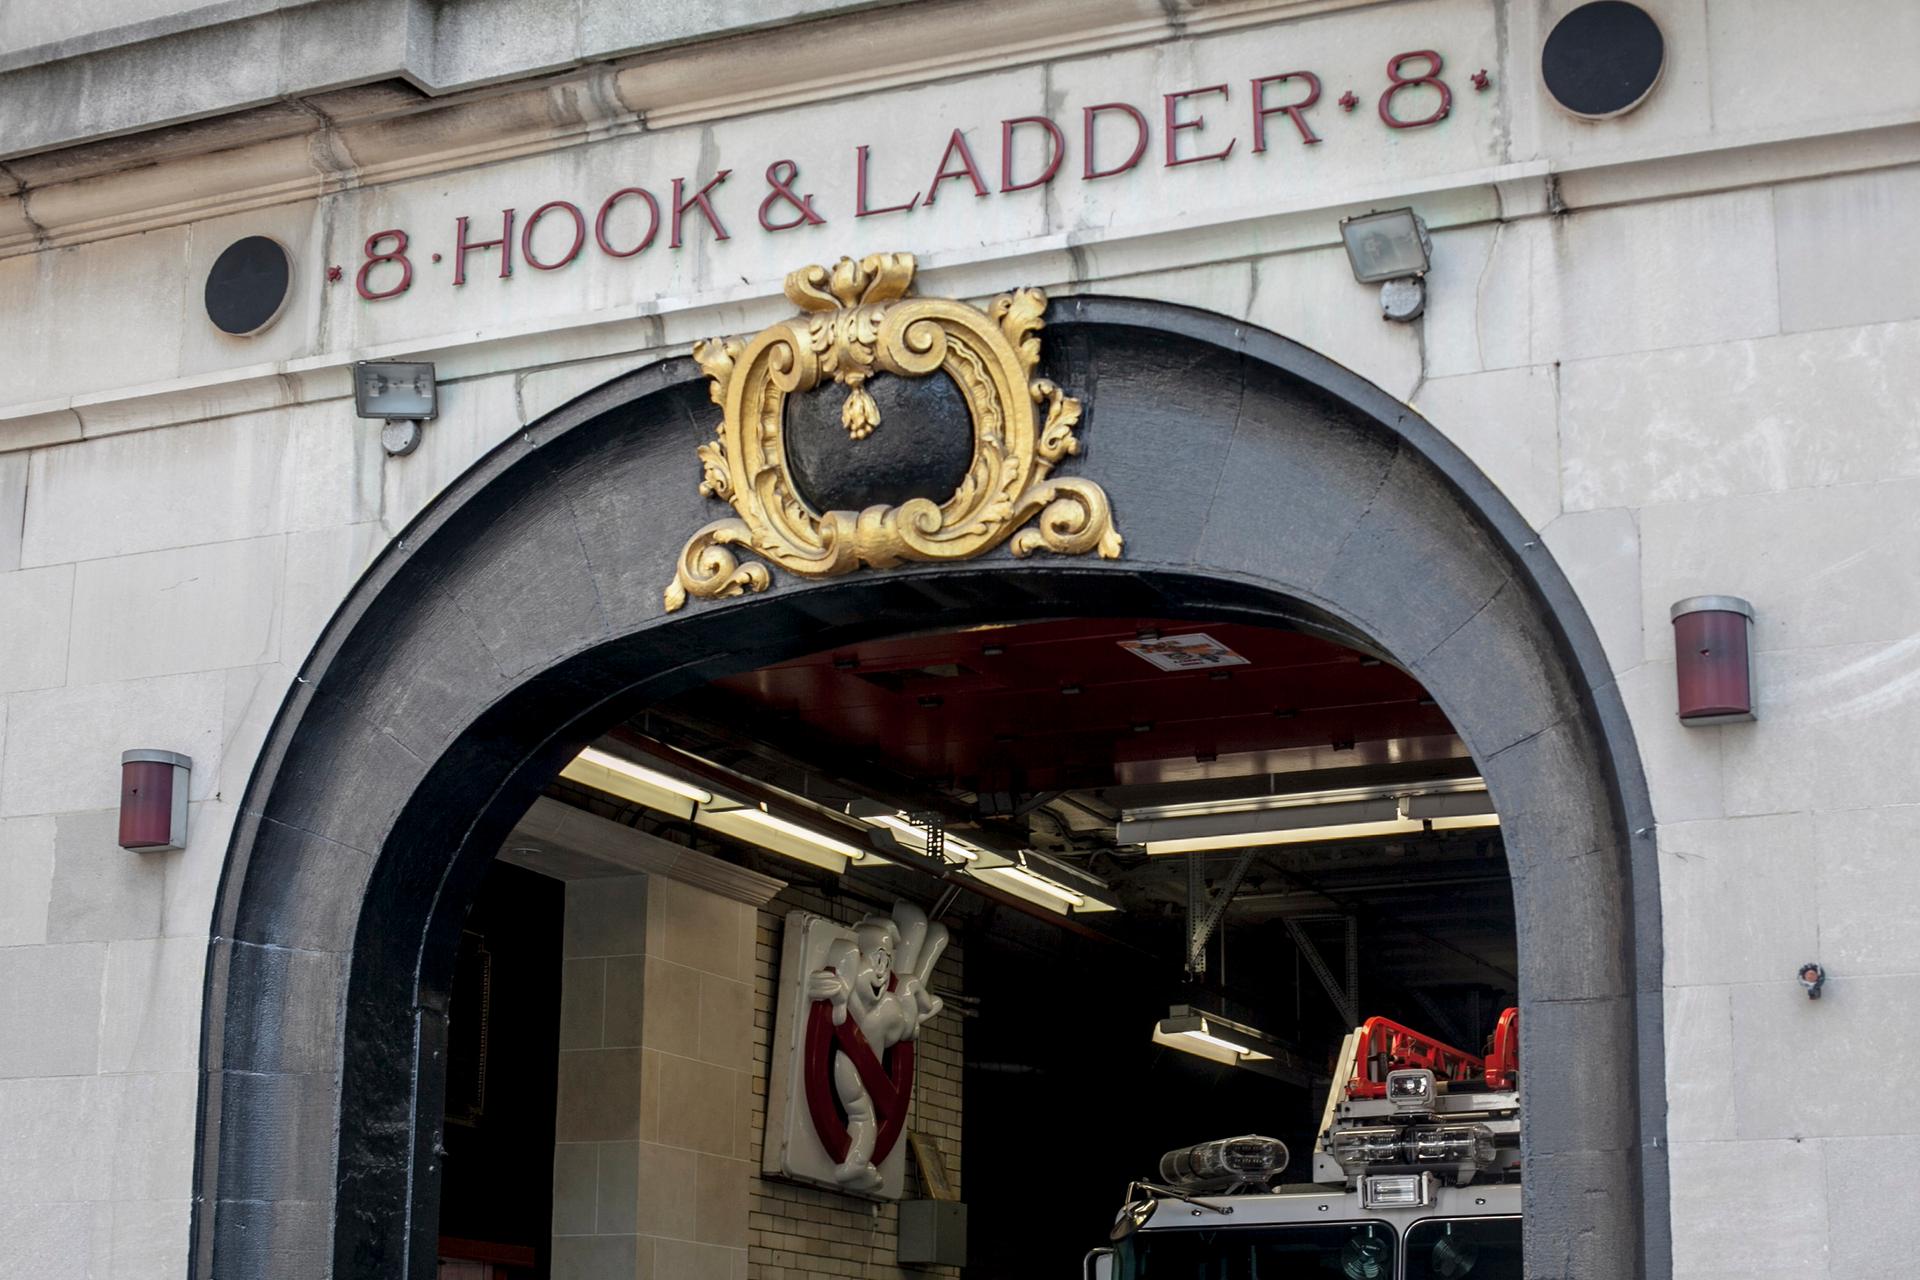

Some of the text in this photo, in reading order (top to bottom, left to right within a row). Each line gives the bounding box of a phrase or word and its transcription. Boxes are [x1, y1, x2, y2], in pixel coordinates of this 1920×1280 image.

[355, 49, 1452, 300] 8 HOOK & LADDER 8
